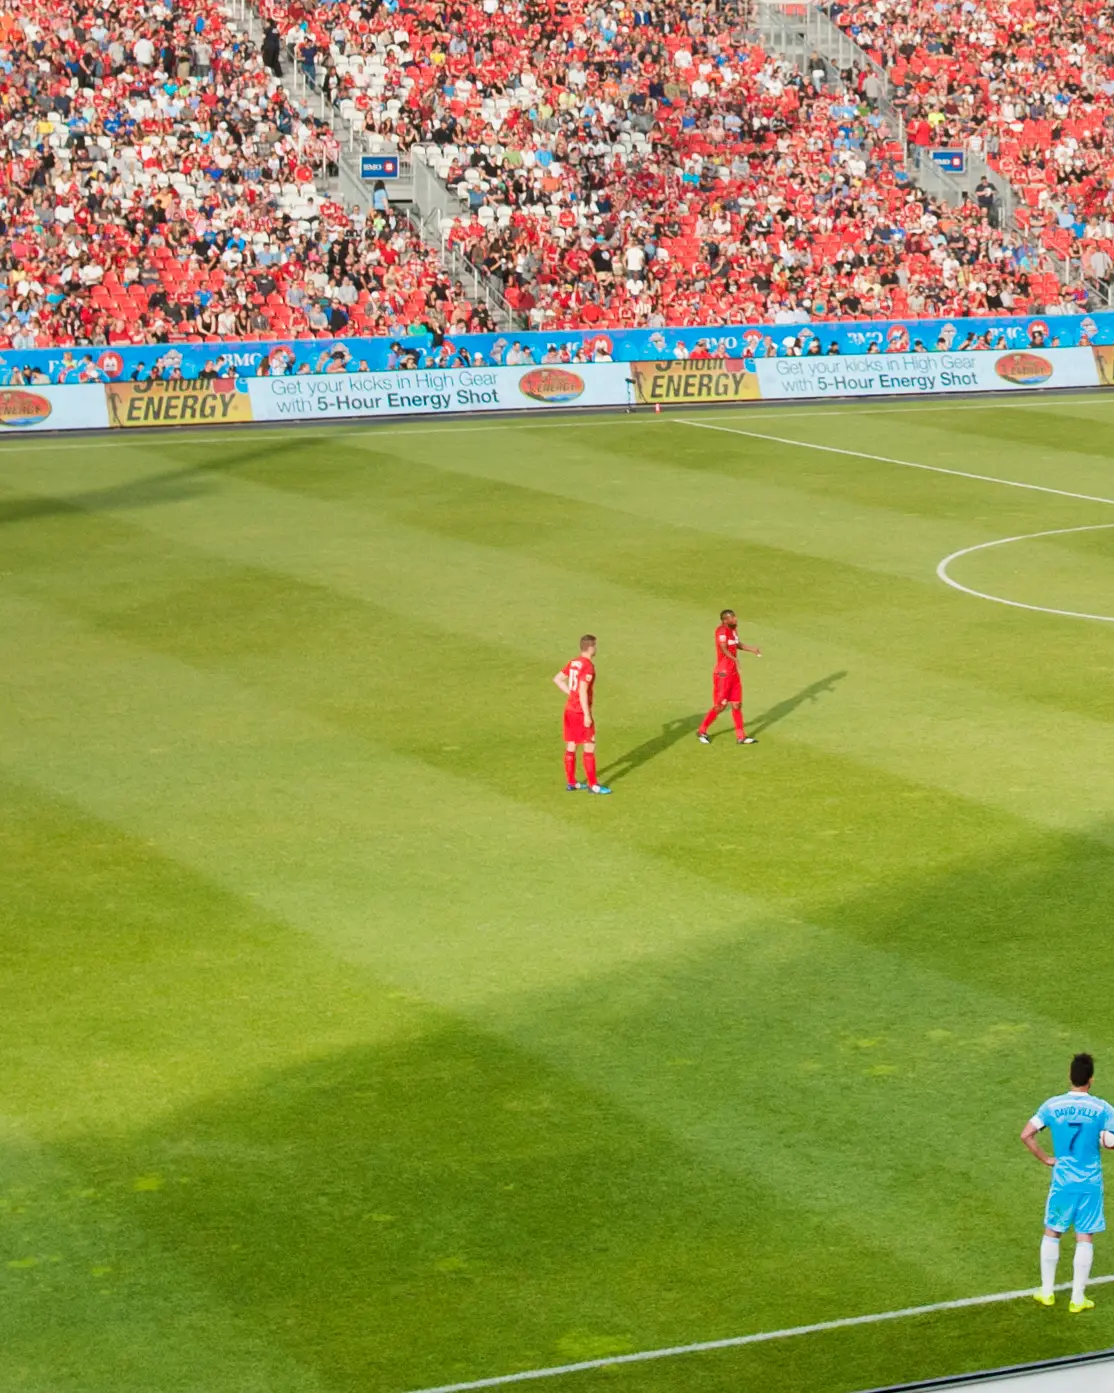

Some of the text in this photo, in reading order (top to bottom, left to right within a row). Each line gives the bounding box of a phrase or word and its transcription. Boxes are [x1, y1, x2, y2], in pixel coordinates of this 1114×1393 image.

[776, 355, 976, 379] Get your kicks in High Gear
[271, 369, 497, 398] Get your kicks in High Gear
[651, 373, 745, 398] ENERGY
[782, 371, 978, 392] with 5-Hour Energy Shot
[127, 394, 236, 421] ENERGY
[276, 387, 499, 414] with 5-Hour Energy Shot
[1068, 1122, 1084, 1153] 7
